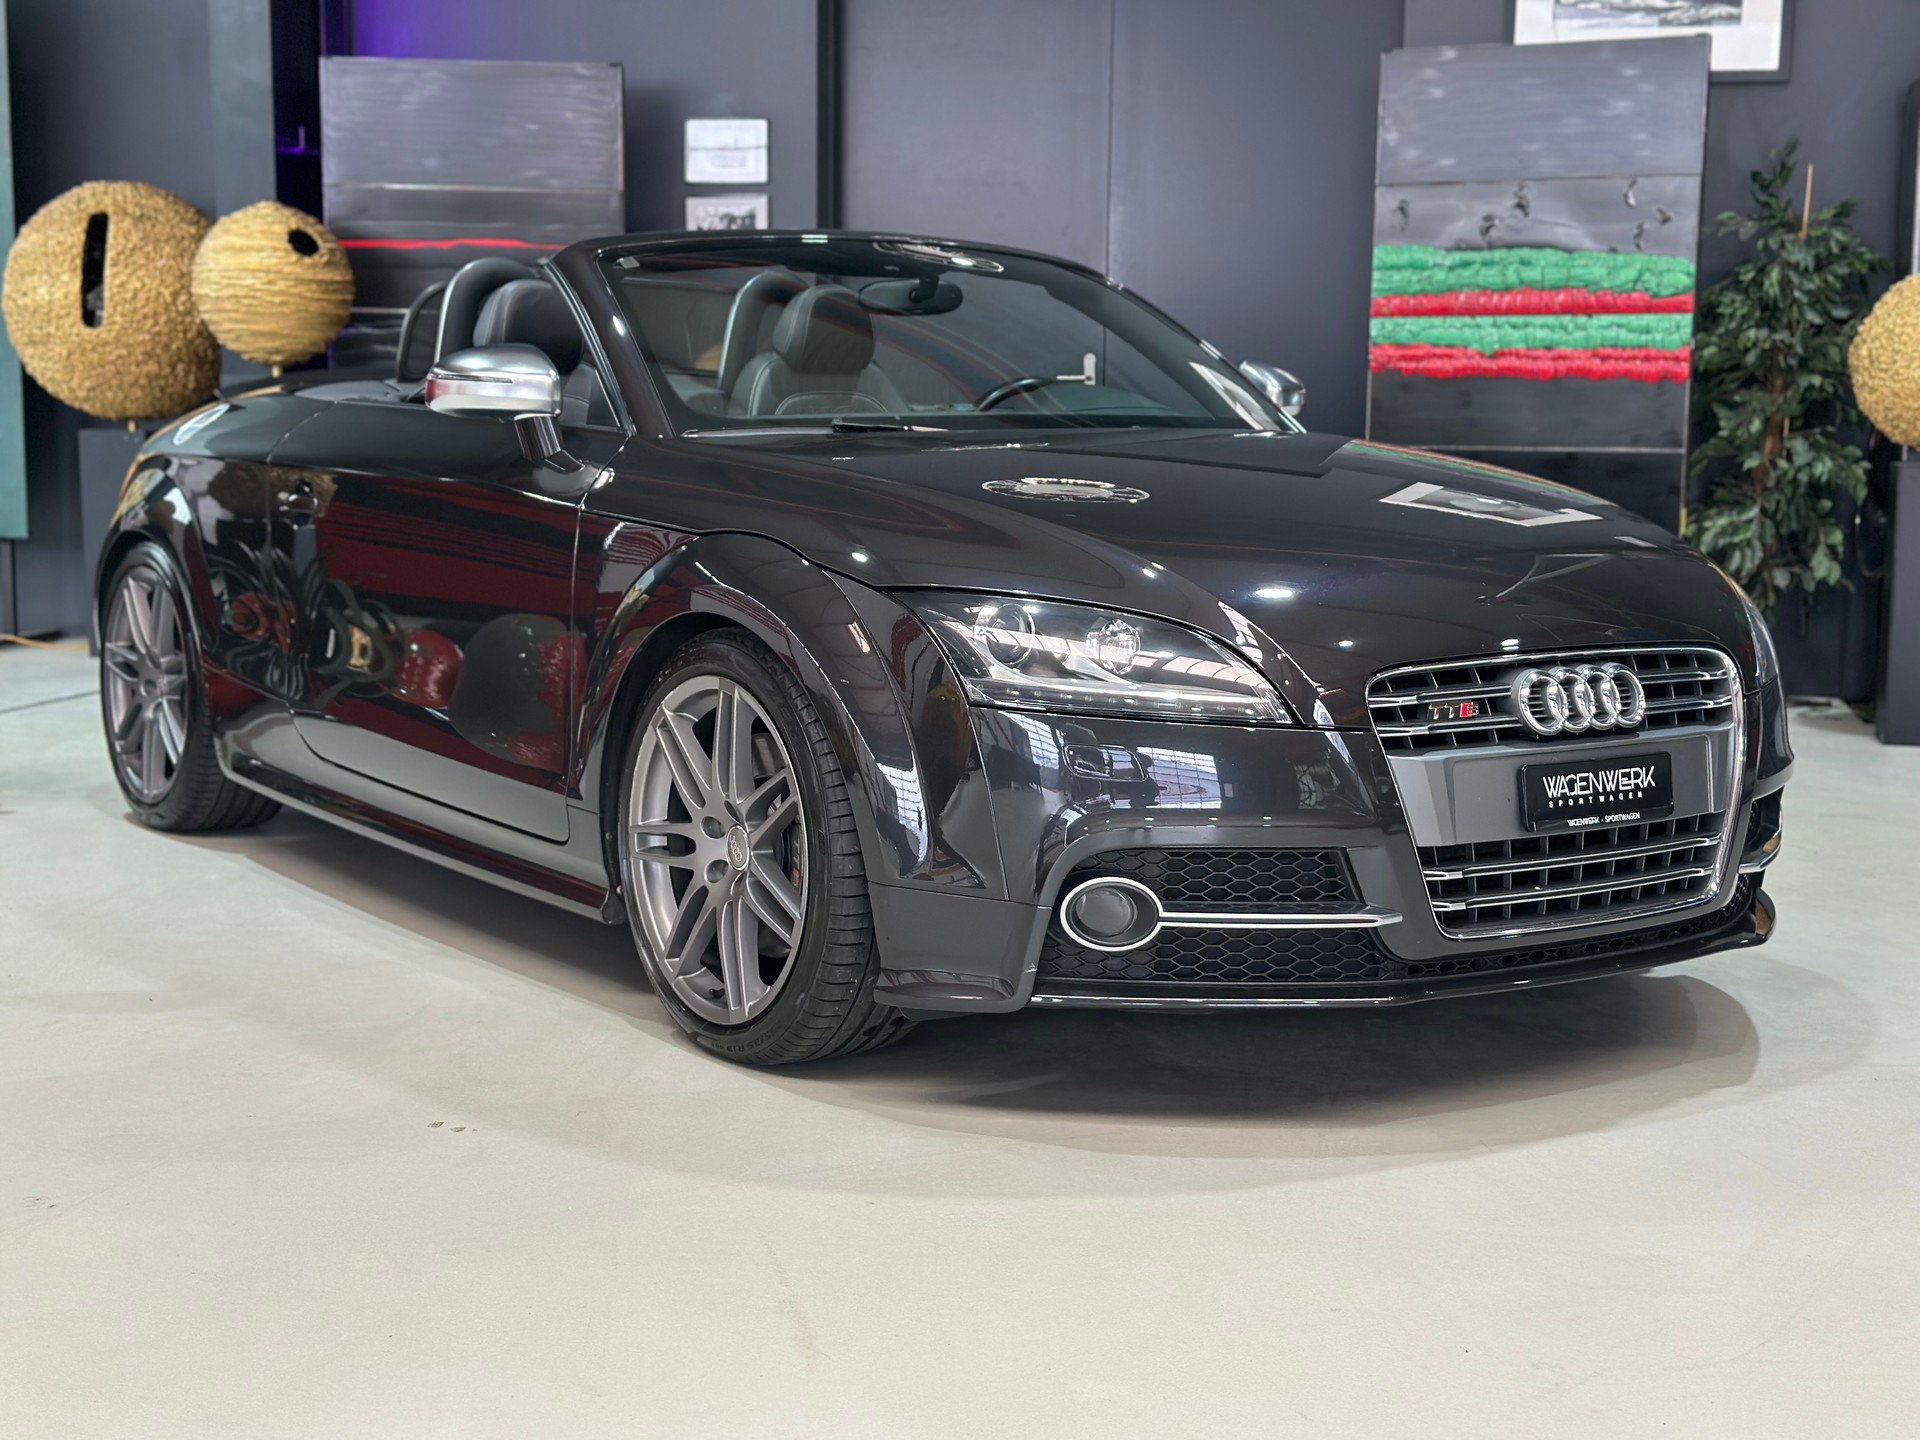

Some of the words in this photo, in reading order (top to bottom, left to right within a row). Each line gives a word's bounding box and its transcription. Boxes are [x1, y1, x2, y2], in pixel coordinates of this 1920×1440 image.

[1428, 702, 1479, 719] TTS
[1542, 765, 1656, 798] WAGENWERK
[1548, 791, 1643, 808] SPORTWAGEN
[1604, 812, 1641, 823] SPORTWAGEN
